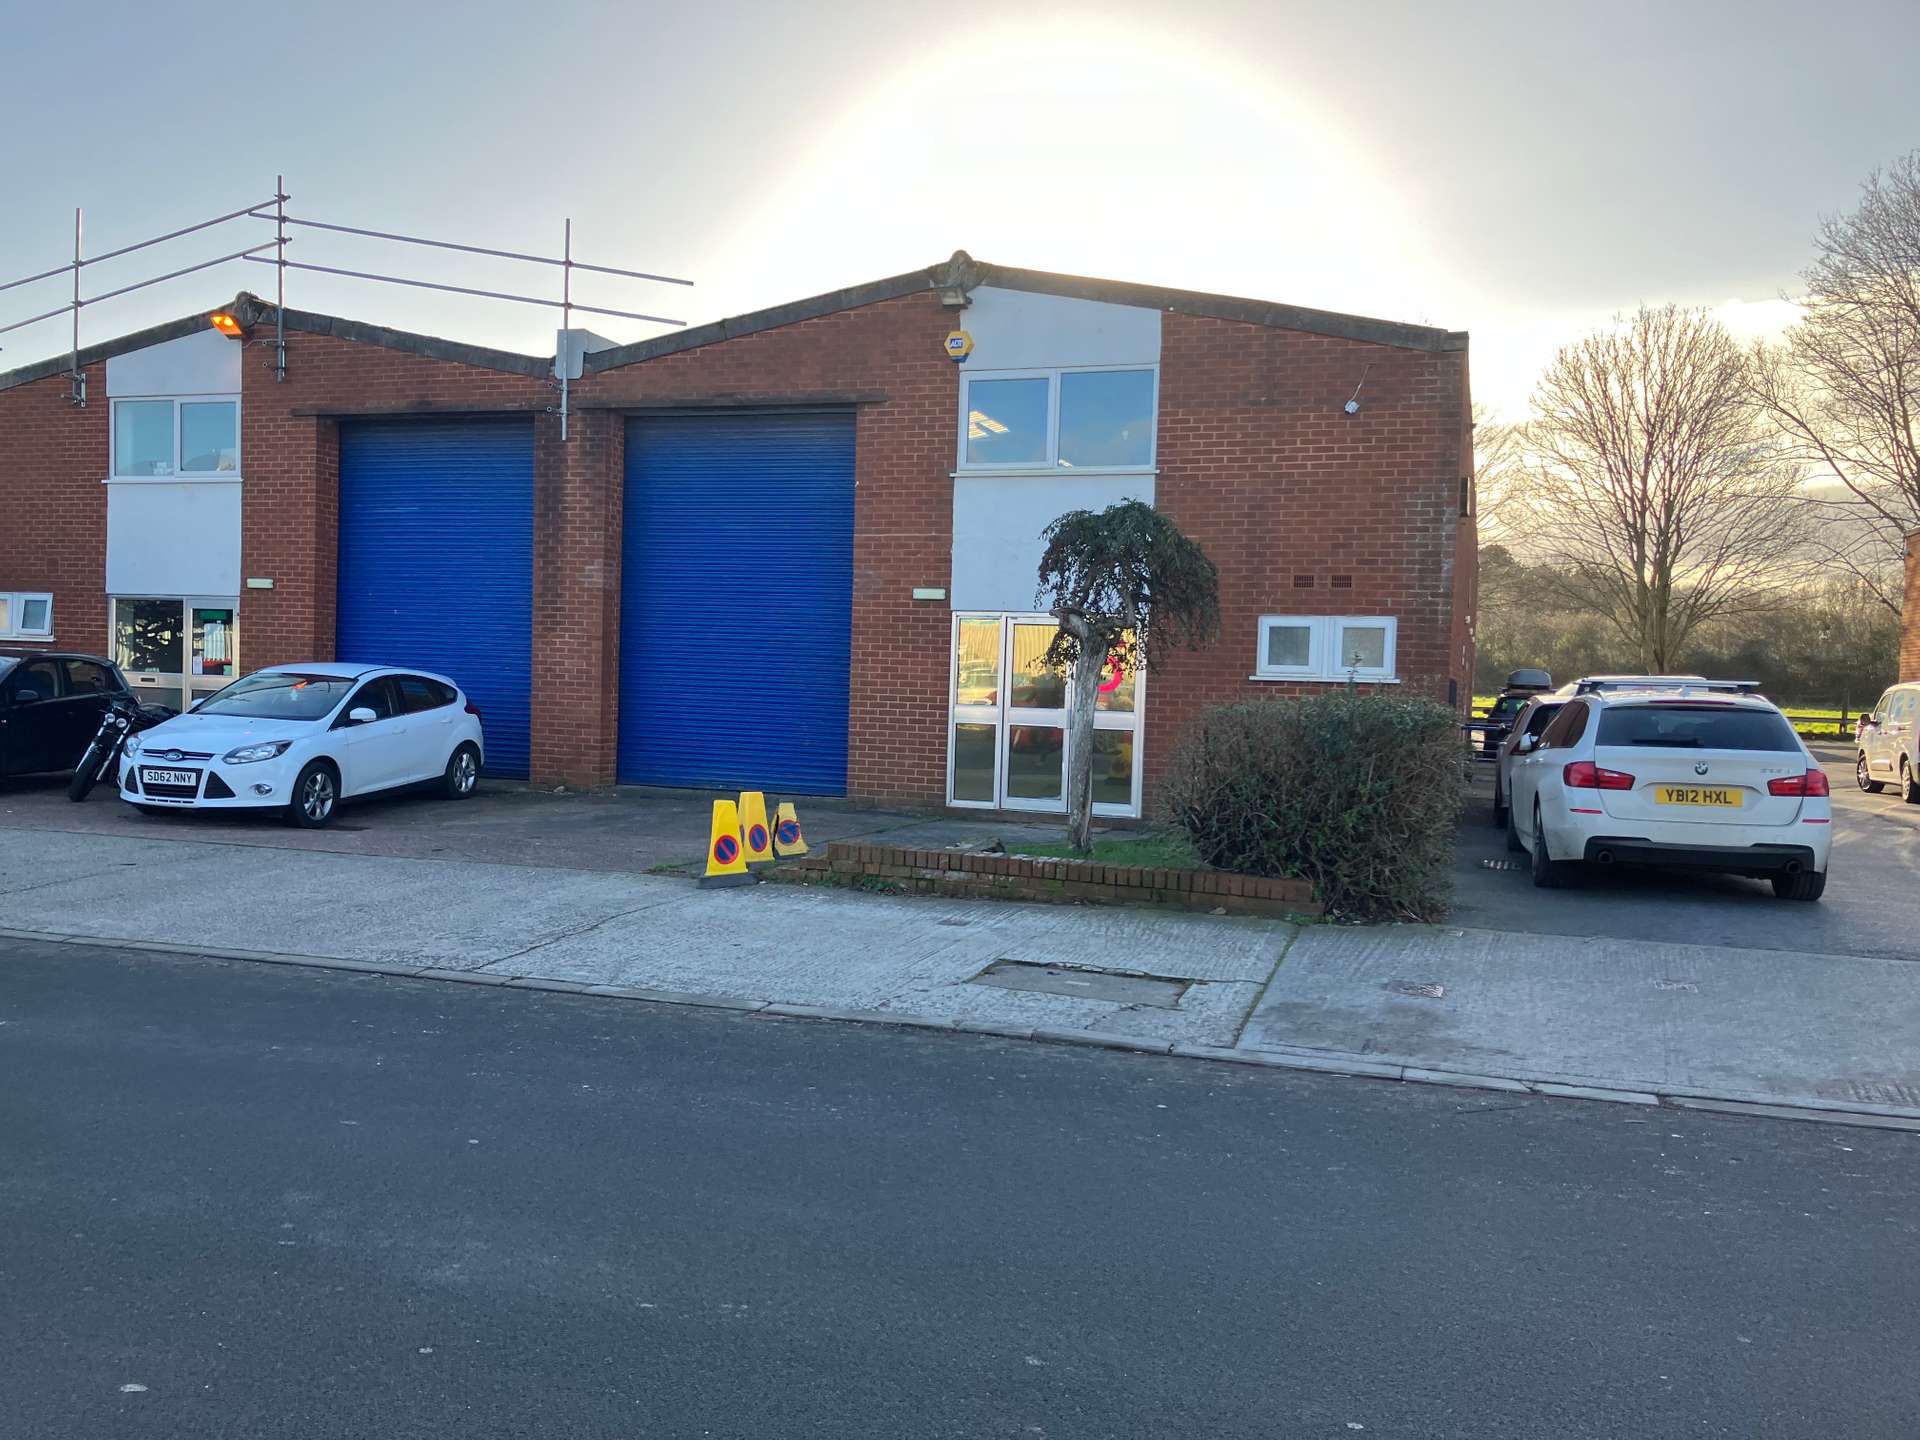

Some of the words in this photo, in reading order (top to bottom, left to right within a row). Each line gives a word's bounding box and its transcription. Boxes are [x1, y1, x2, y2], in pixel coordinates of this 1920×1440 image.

[147, 771, 172, 782] SD62
[174, 772, 192, 783] NNY
[1665, 789, 1699, 803] YB12
[1703, 790, 1733, 804] HXL
